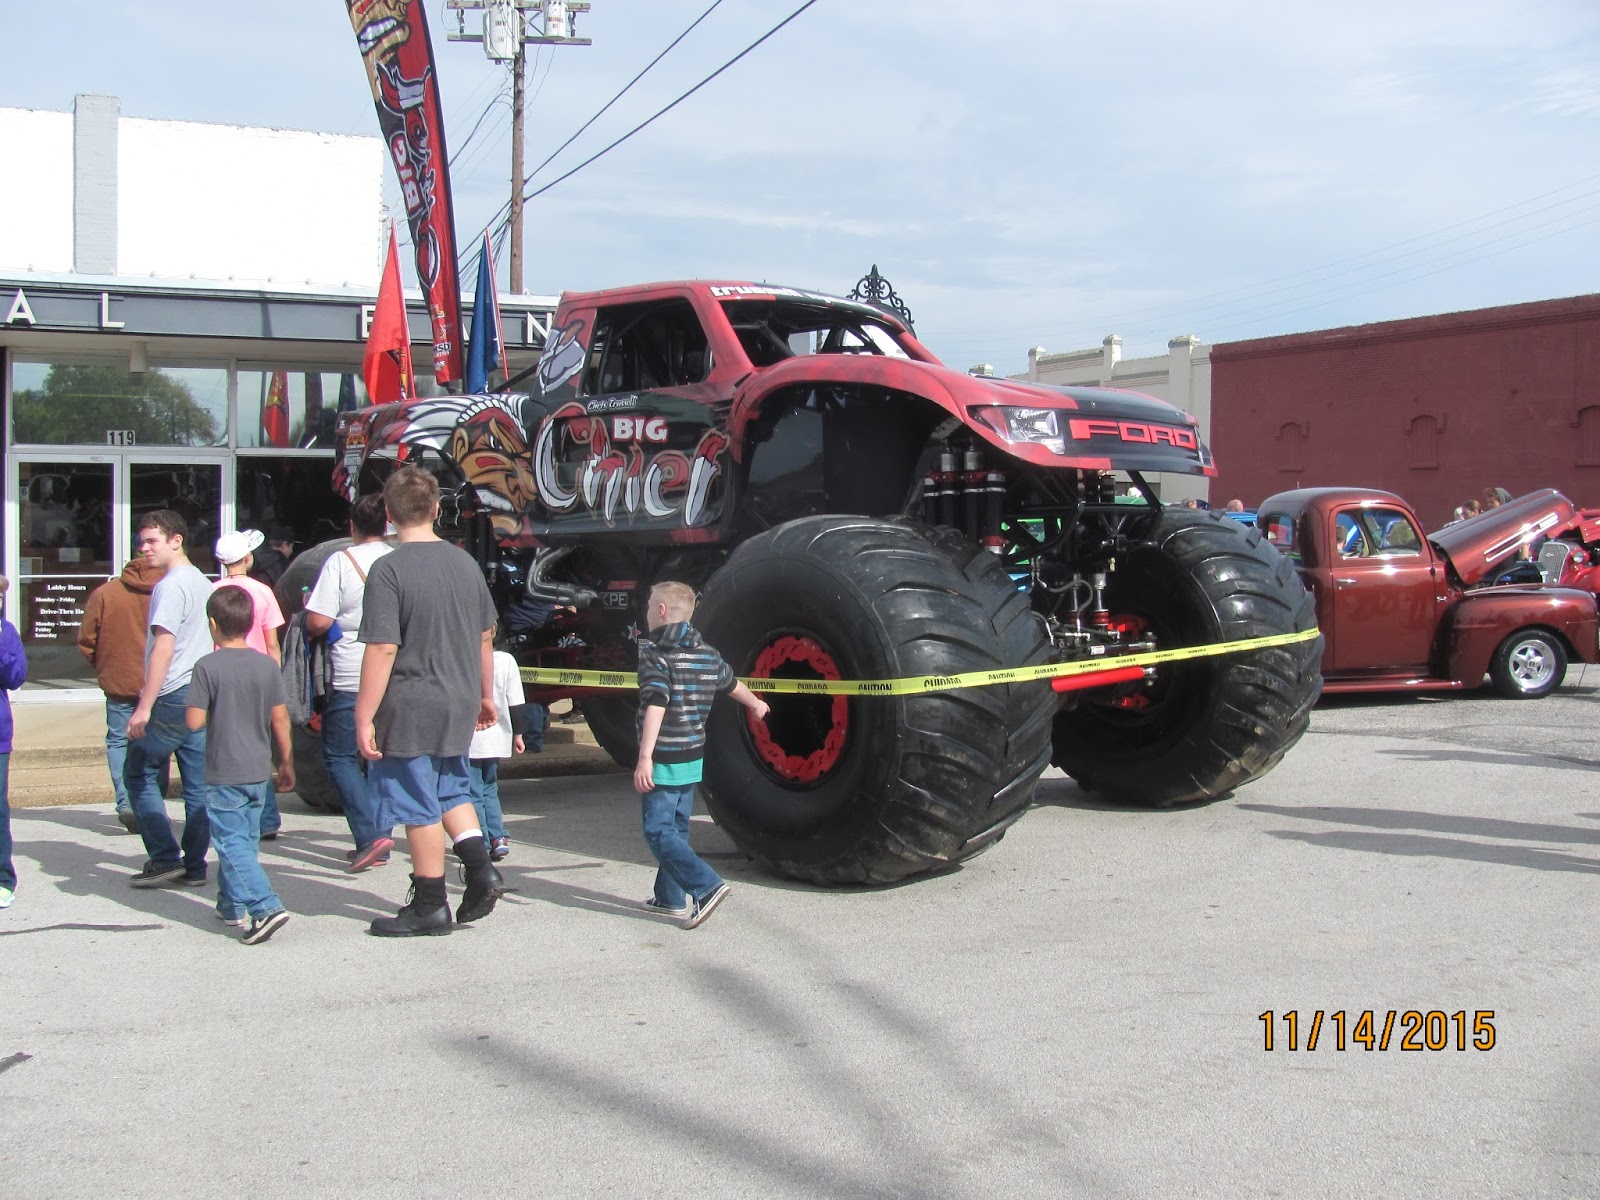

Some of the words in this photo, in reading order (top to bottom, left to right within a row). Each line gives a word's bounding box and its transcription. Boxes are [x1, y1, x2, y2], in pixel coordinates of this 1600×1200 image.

[391, 136, 420, 212] BIG
[109, 431, 134, 445] 119
[612, 416, 669, 443] BIG
[1069, 419, 1197, 449] FORD
[533, 402, 730, 528] Chief
[47, 584, 67, 592] Lobby
[559, 672, 582, 683] CAUTION
[748, 681, 776, 690] CAUTION
[858, 683, 892, 691] CAUTION
